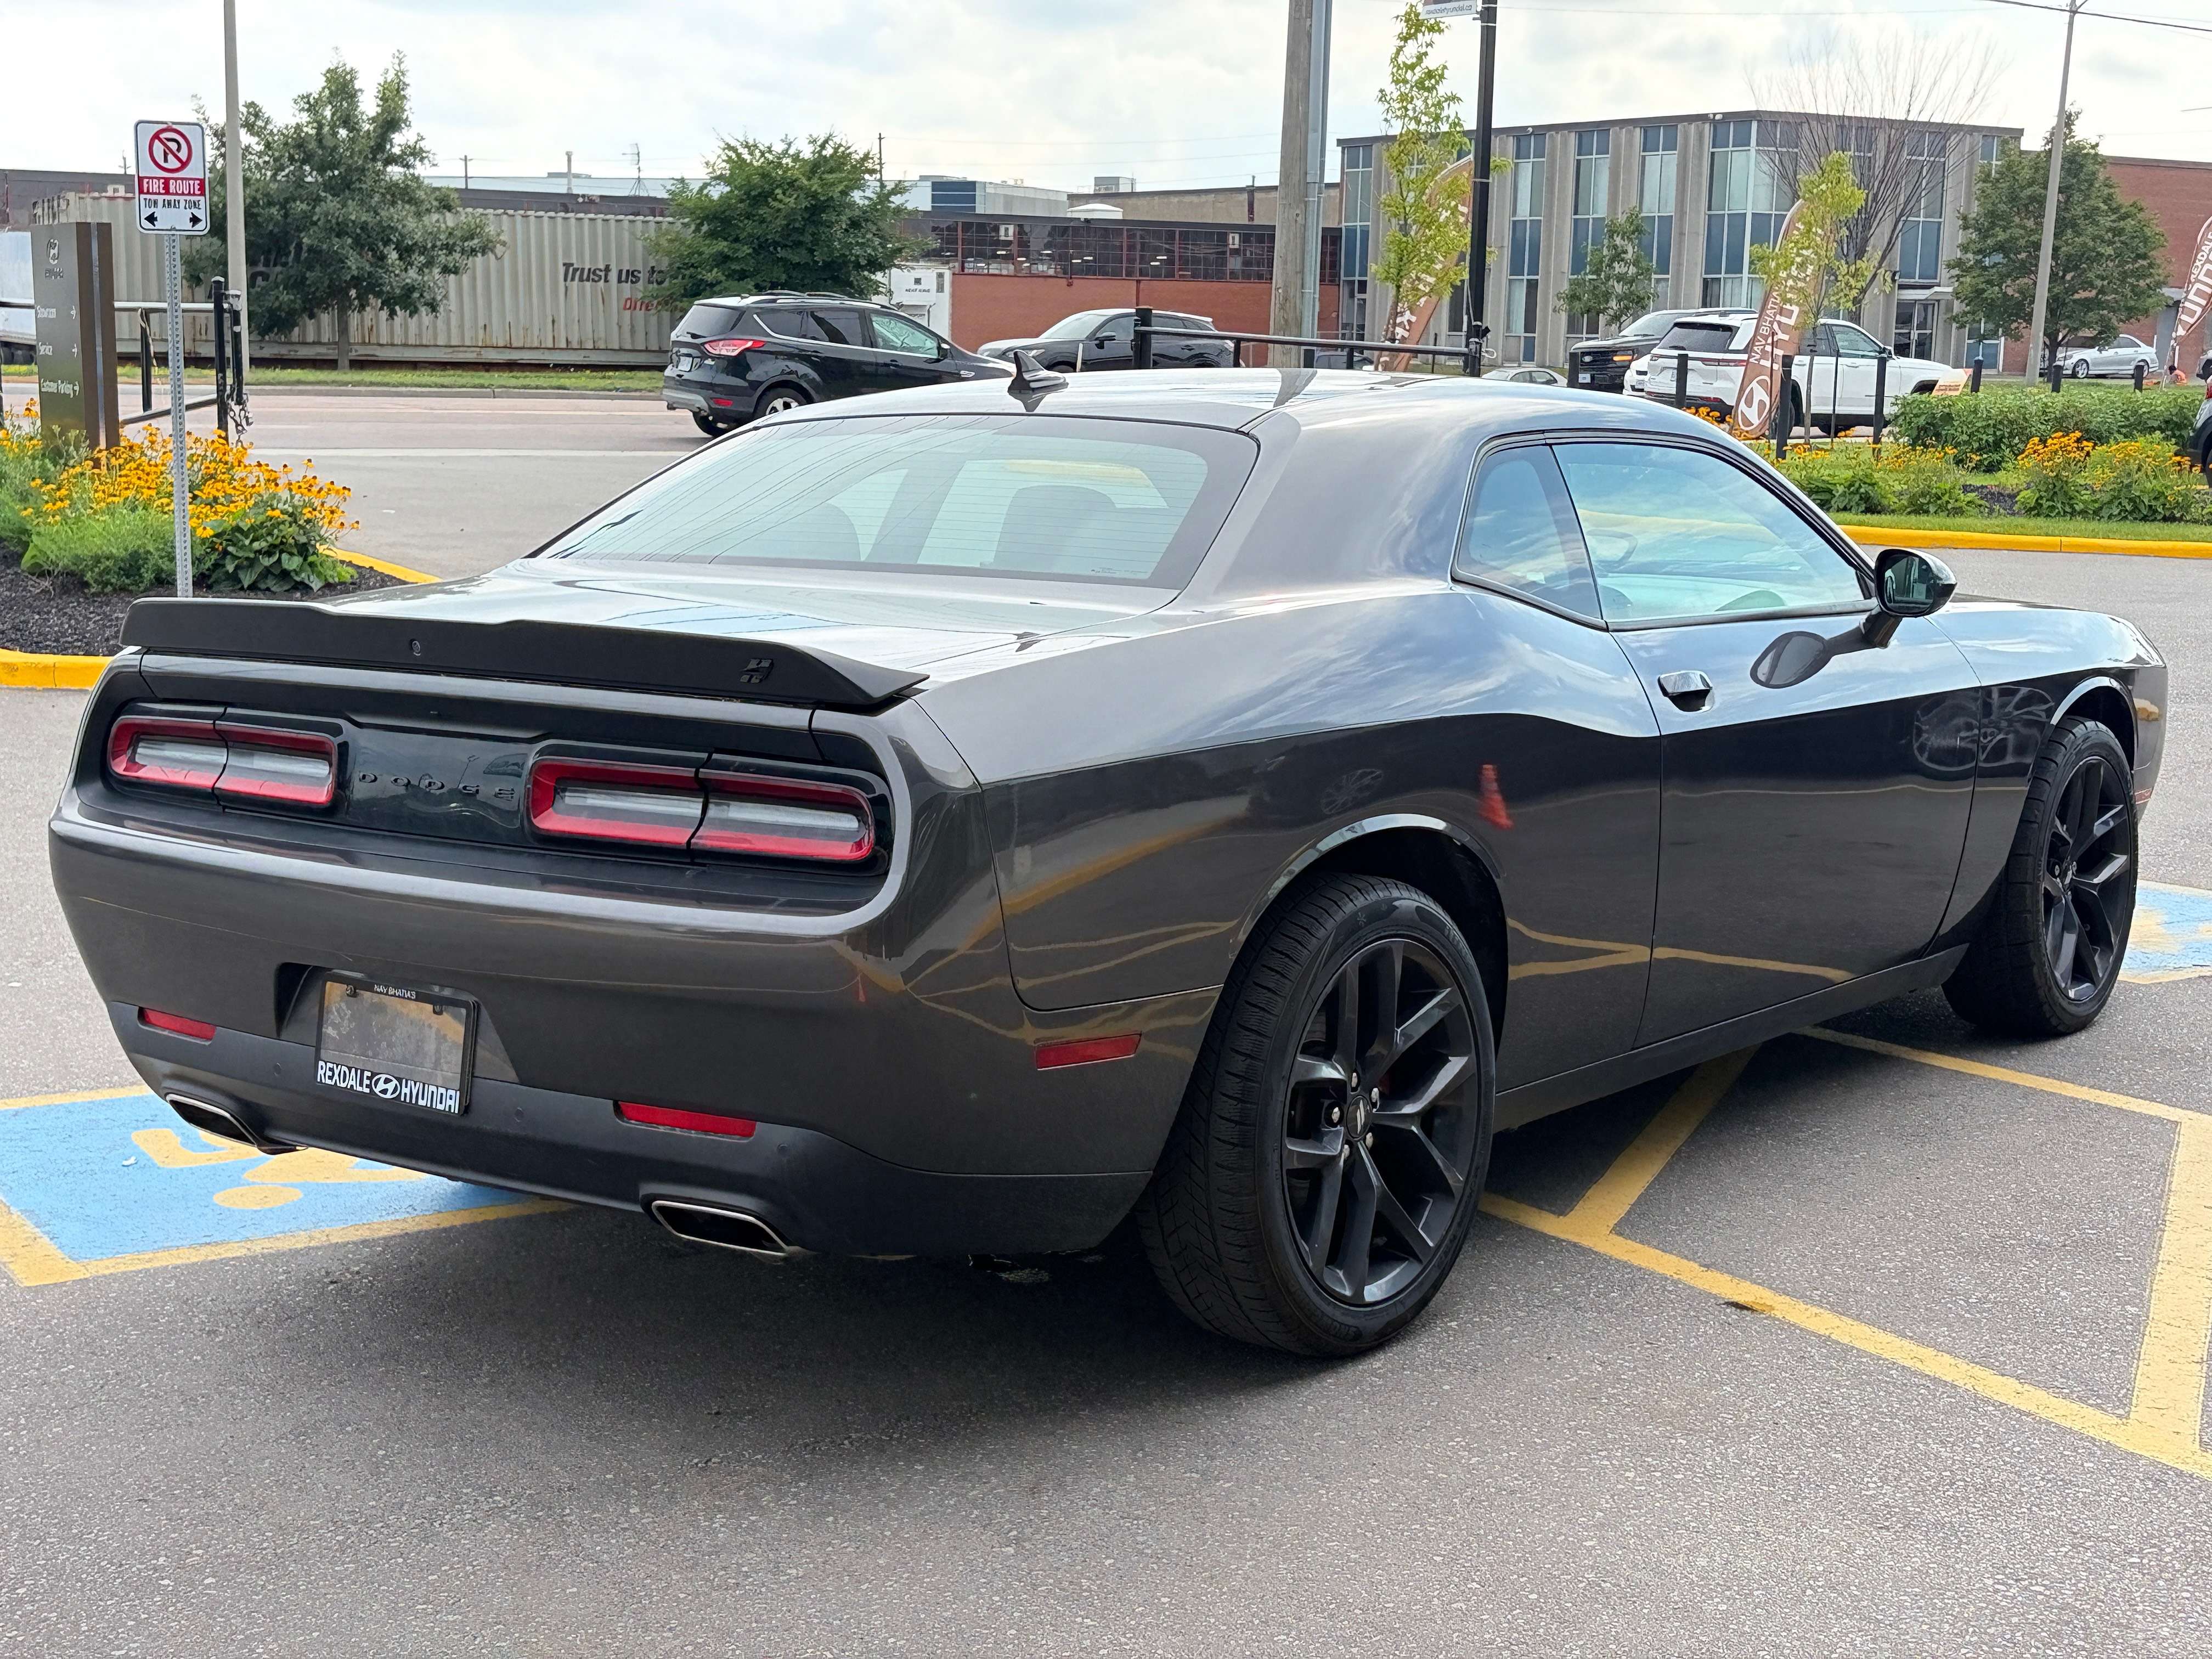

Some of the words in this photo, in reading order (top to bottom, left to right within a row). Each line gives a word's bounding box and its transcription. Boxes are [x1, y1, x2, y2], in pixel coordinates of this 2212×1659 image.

[143, 178, 166, 193] FIRE
[169, 180, 201, 194] ROUTE
[143, 198, 159, 209] TOW
[162, 198, 180, 209] AWAY
[184, 200, 202, 210] ZONE
[562, 262, 612, 283] Trust
[617, 269, 641, 284] us
[647, 266, 667, 285] to
[1749, 335, 1766, 364] NAV
[358, 772, 516, 802] DODGE
[317, 1060, 371, 1093] REXDALE
[400, 1079, 460, 1114] HYUNDAI
